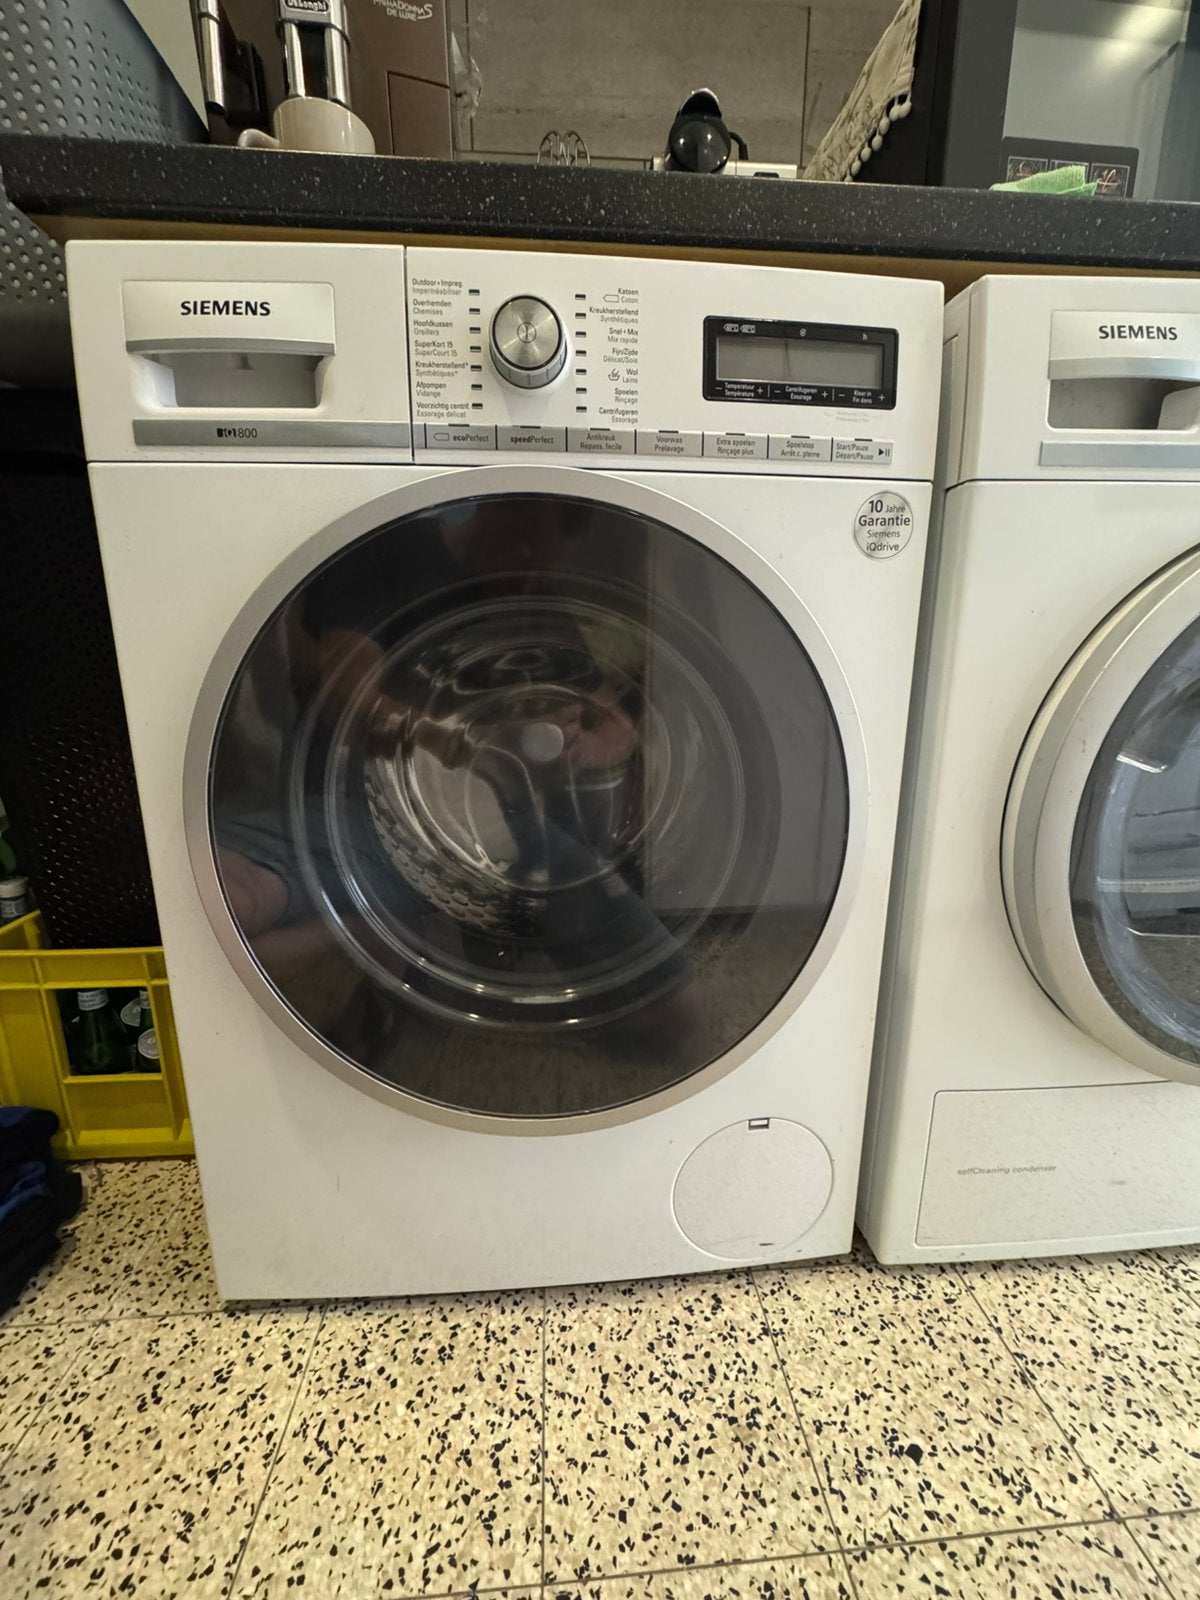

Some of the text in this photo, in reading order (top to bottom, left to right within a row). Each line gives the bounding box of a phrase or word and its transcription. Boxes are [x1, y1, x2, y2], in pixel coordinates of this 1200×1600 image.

[386, 7, 417, 22] DE LUXE
[617, 287, 639, 296] Katoen
[412, 298, 452, 307] Overhemden
[621, 295, 639, 304] Coton
[180, 299, 271, 317] SIEMENS
[413, 307, 443, 315] Chemises
[589, 306, 639, 316] Kreukherstellend
[413, 319, 453, 328] Hoofdkussen
[413, 328, 439, 336] Oreillers
[1098, 324, 1178, 341] SIEMENS
[414, 340, 446, 349] SuperKort
[415, 348, 458, 357] SuperCourt 15
[612, 347, 639, 357] Fijn/Zijde
[626, 368, 639, 376] Wol
[622, 376, 639, 384] Laine
[416, 381, 447, 390] Afpompen
[416, 389, 441, 399] Vidange
[614, 387, 639, 396] Spoelen
[416, 401, 449, 411] Voorzichtig
[416, 409, 445, 419] Essorage
[599, 407, 639, 417] Centrifugeren
[611, 415, 639, 425] Essorage
[453, 433, 489, 443] ecoPerfect
[510, 435, 554, 445] speedPerfect
[586, 433, 616, 442] Antikreuk
[656, 435, 683, 444] Voorwas
[716, 437, 756, 448] Extra spoelen
[604, 441, 622, 451] facile
[786, 440, 815, 450] Spoelstop
[836, 442, 870, 452] Start/Pauze
[741, 448, 755, 456] plus
[801, 450, 821, 459] pleine
[835, 450, 875, 461] Départ/Pause
[868, 499, 906, 514] 10 Jahre
[858, 513, 911, 527] Garantie
[867, 529, 901, 539] Siemens
[866, 541, 900, 552] iQdrive
